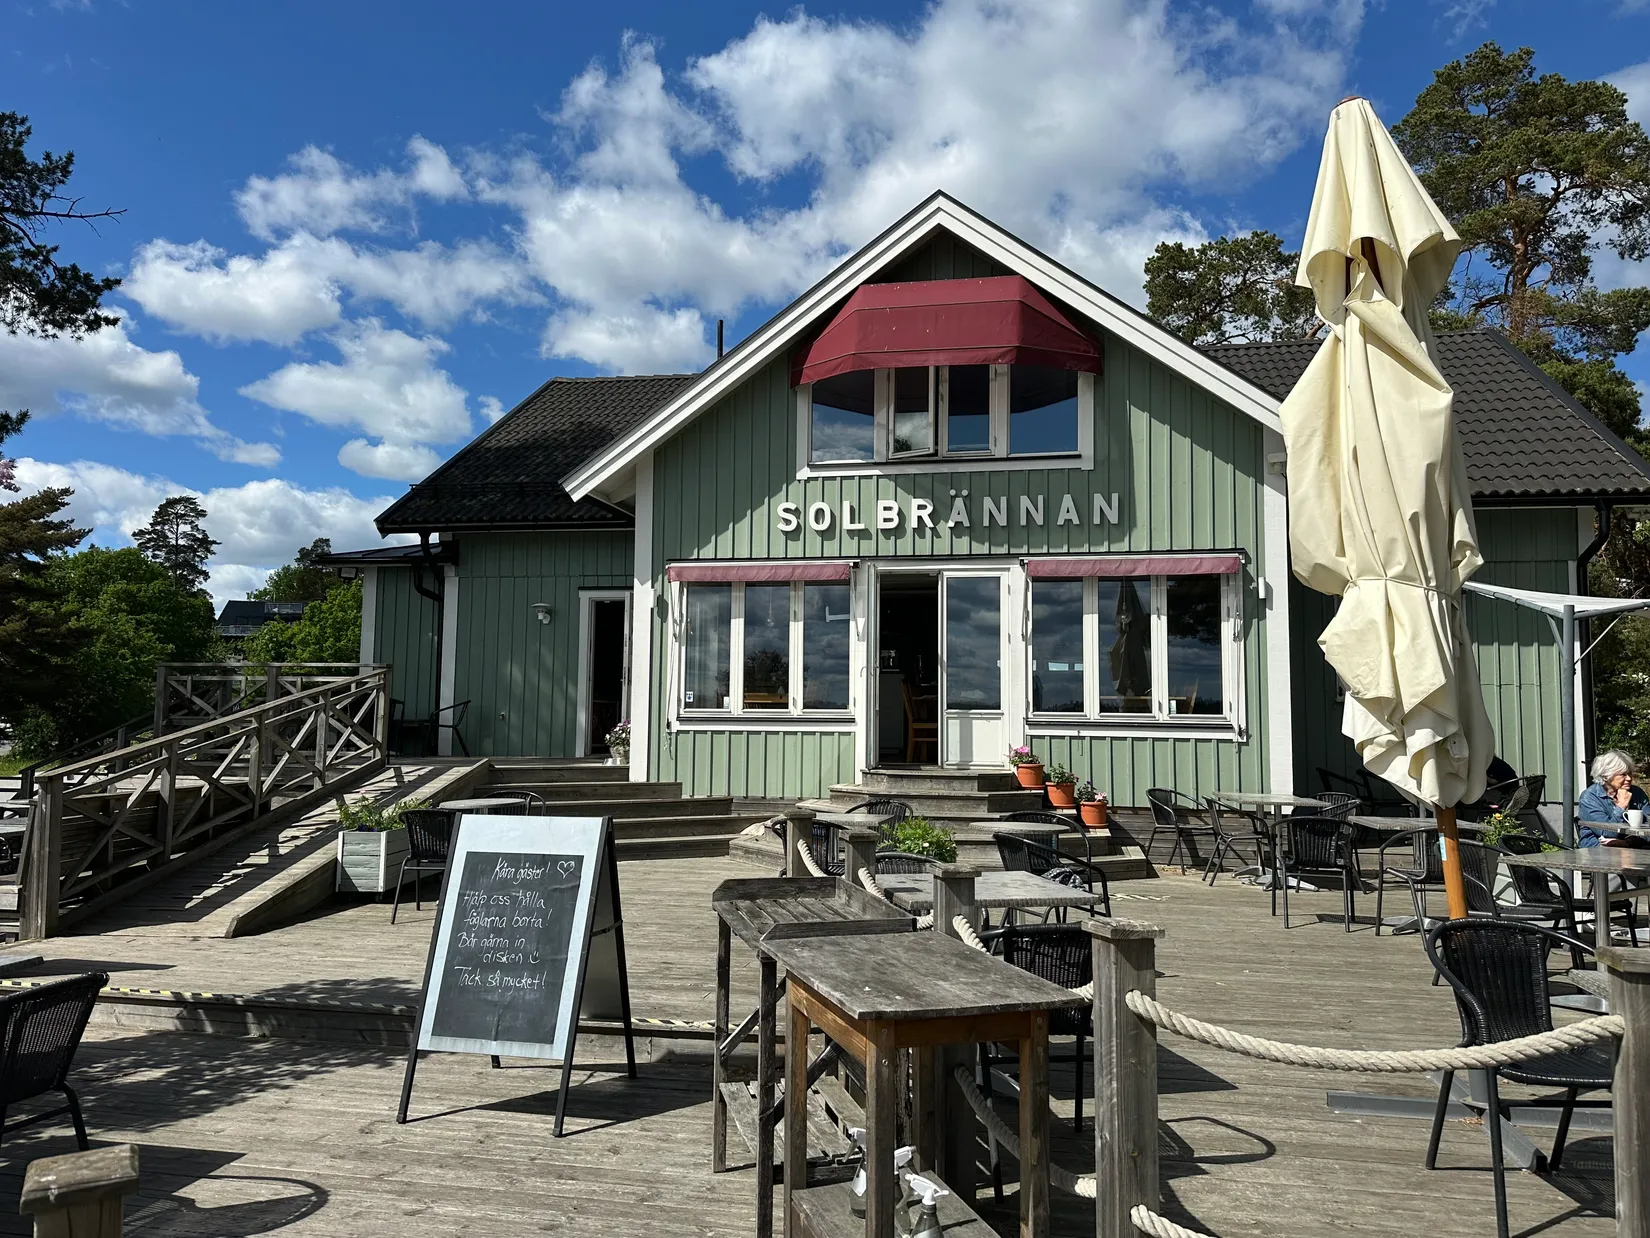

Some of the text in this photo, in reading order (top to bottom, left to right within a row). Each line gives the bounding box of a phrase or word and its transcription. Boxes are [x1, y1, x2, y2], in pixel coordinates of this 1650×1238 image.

[776, 488, 1119, 532] SOLBRÄNNAN
[491, 857, 551, 885] Kära gäster!
[489, 894, 510, 905] oss
[512, 891, 546, 909] hålla
[511, 909, 552, 929] borta!
[514, 935, 526, 950] in
[454, 966, 548, 996] Tack så mycket!
